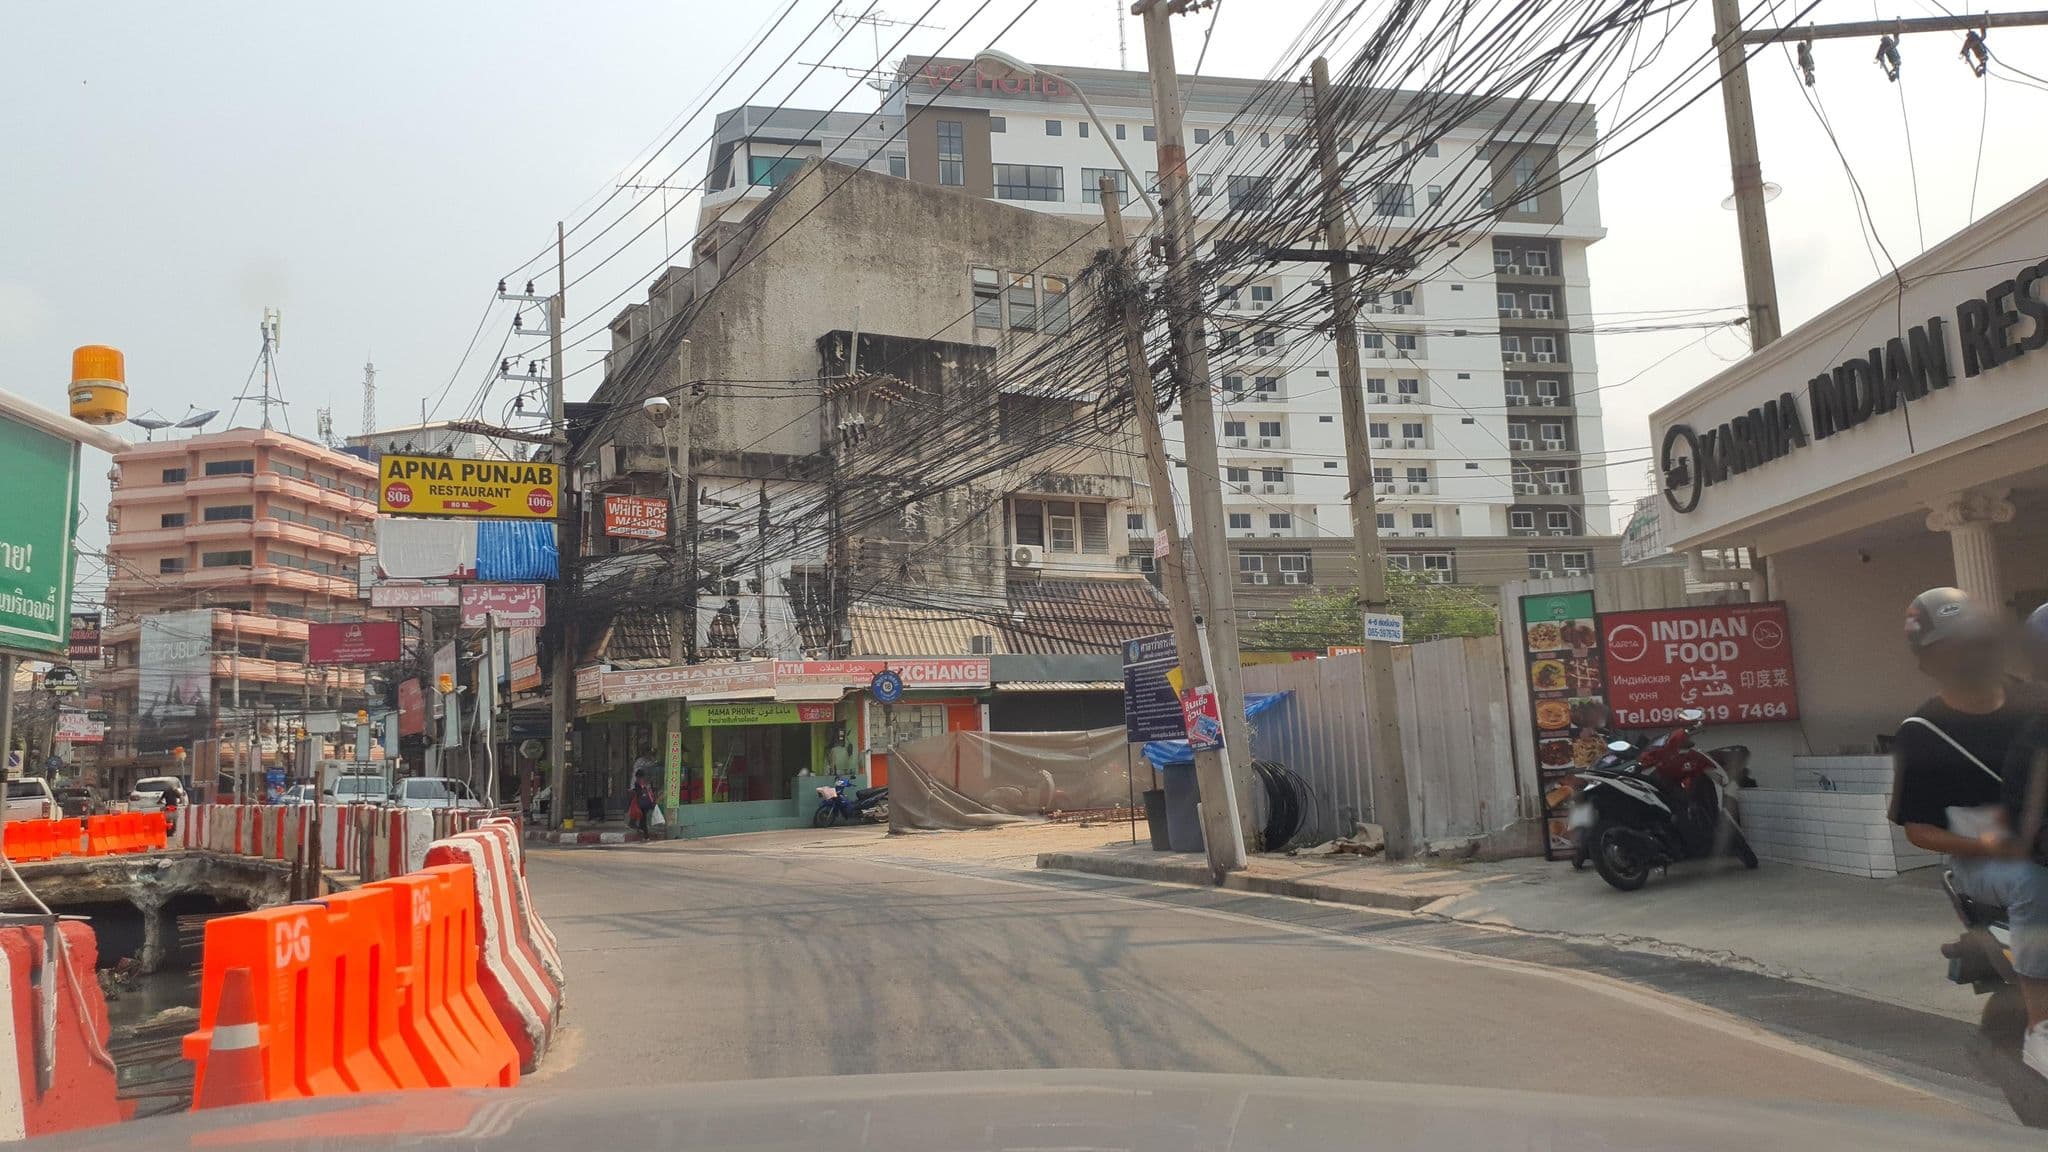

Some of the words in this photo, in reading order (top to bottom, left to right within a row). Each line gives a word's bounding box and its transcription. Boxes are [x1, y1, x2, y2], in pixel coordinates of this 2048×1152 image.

[1698, 392, 1807, 488] KARMA
[1807, 315, 1950, 441] INDIAN
[388, 460, 453, 481] APNA
[462, 463, 553, 485] PUNJAB
[429, 485, 512, 498] RESTAURANT
[608, 503, 643, 517] WHITE
[615, 516, 666, 529] MANSION
[1651, 616, 1749, 641] INDIAN
[1664, 641, 1740, 664] FOOD
[623, 665, 757, 685] EXCHANGE
[777, 663, 805, 675] ATM
[1740, 668, 1790, 689] 印度菜
[1613, 675, 1671, 687] Индийская
[1629, 691, 1659, 703] кухня
[1738, 702, 1789, 719] 7464
[412, 887, 432, 924] DG
[275, 915, 311, 969] DG
